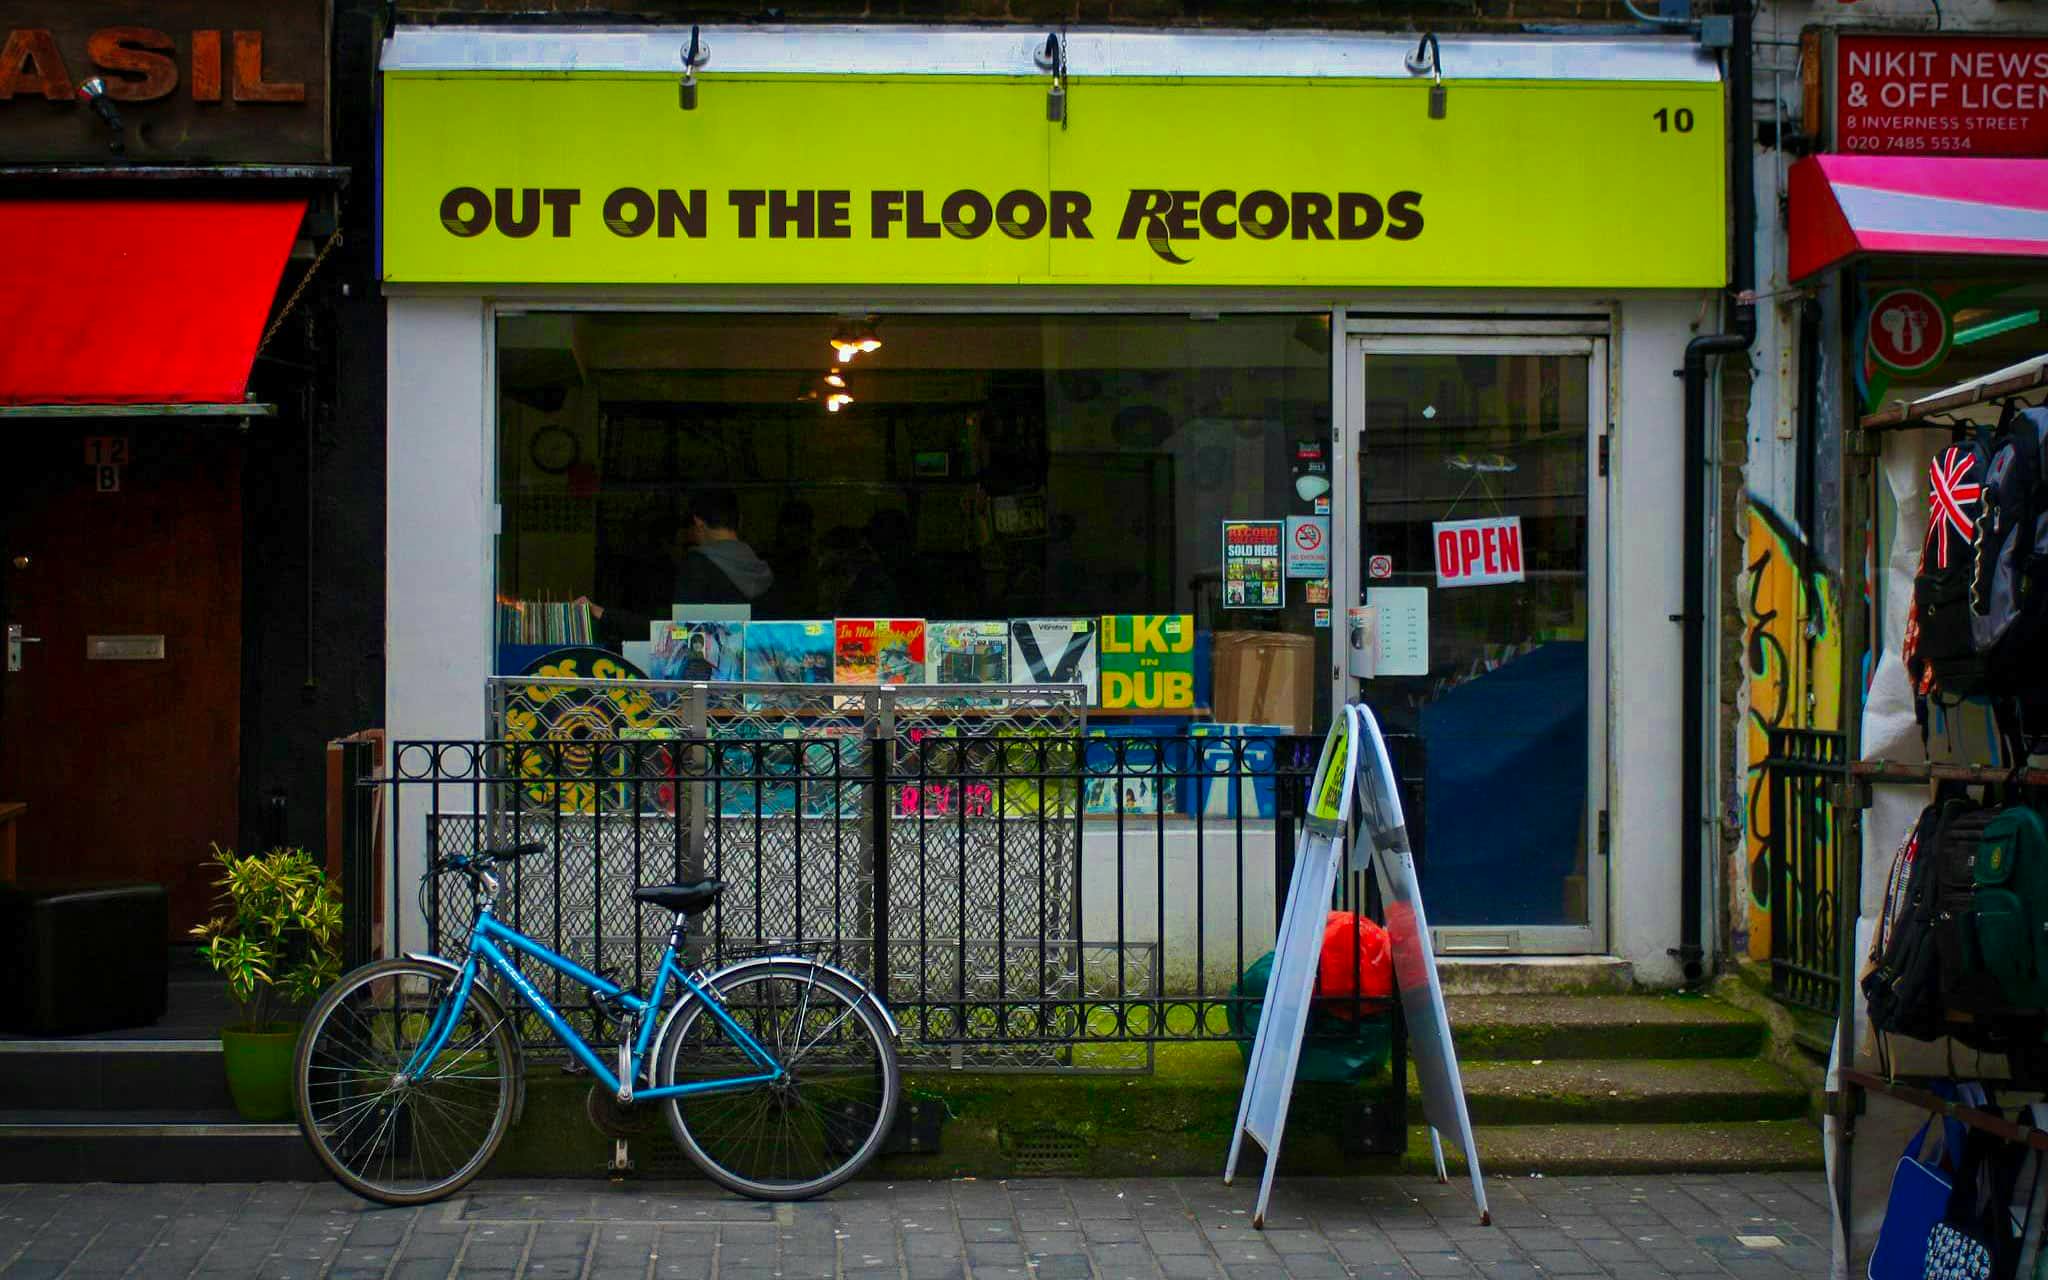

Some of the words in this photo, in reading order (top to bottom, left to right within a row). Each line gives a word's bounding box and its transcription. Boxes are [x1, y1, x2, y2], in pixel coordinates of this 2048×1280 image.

[0, 26, 305, 102] ASIL
[1847, 51, 1937, 78] NIKIT
[1847, 83, 1869, 109] &
[1880, 83, 1949, 109] OFF
[1653, 108, 1694, 133] 10
[1847, 116, 1857, 129] 8
[1862, 116, 1960, 130] INVERNESS
[1965, 117, 2029, 130] STREET
[1847, 136, 1880, 150] 020
[1886, 136, 1925, 150] 7485
[1931, 137, 1971, 150] 5534
[440, 187, 580, 238] OUT
[603, 187, 707, 238] ON
[728, 189, 851, 239] THE
[871, 189, 1093, 240] FLOOR
[1117, 189, 1424, 265] RECORDS
[92, 438, 125, 463] 12
[1228, 545, 1253, 557] SOLD
[1254, 545, 1278, 557] HERE
[1438, 526, 1521, 578] OPEN
[840, 624, 852, 639] In
[1102, 615, 1194, 653] LKJ
[1140, 658, 1159, 667] IN
[1102, 671, 1194, 708] DUB
